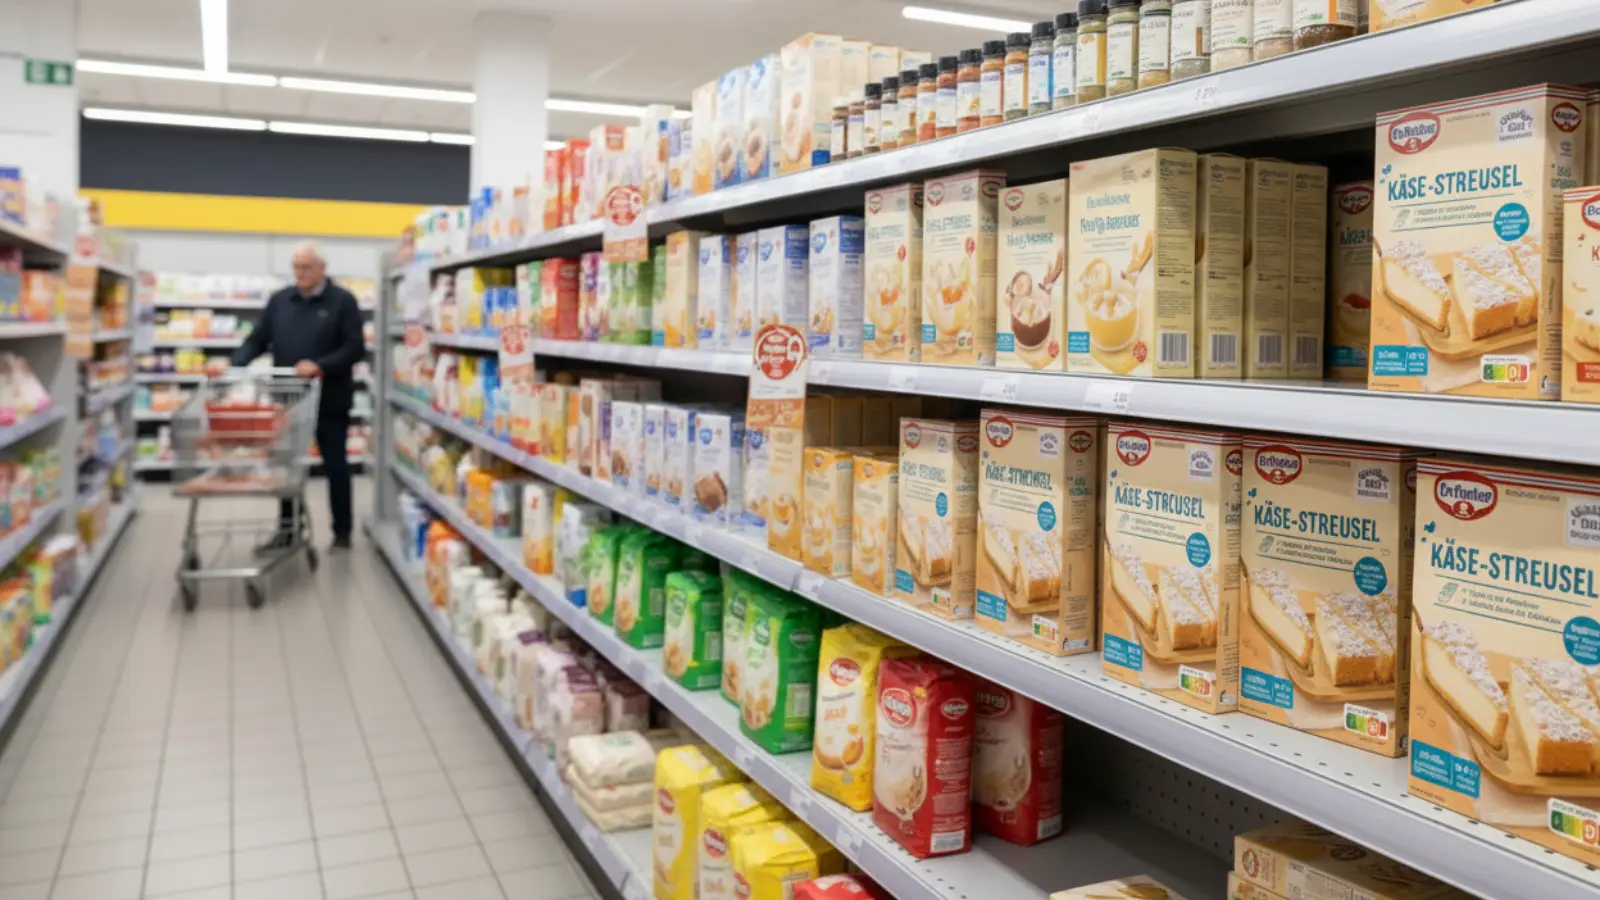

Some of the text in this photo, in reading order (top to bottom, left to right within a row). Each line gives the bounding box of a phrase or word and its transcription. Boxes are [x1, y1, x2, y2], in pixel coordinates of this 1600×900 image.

[1388, 164, 1522, 201] KÄSE-STREUSEL
[1254, 500, 1380, 543] KÄSE-STREUSEL
[1431, 537, 1599, 599] KÄSE-STREUSEL
